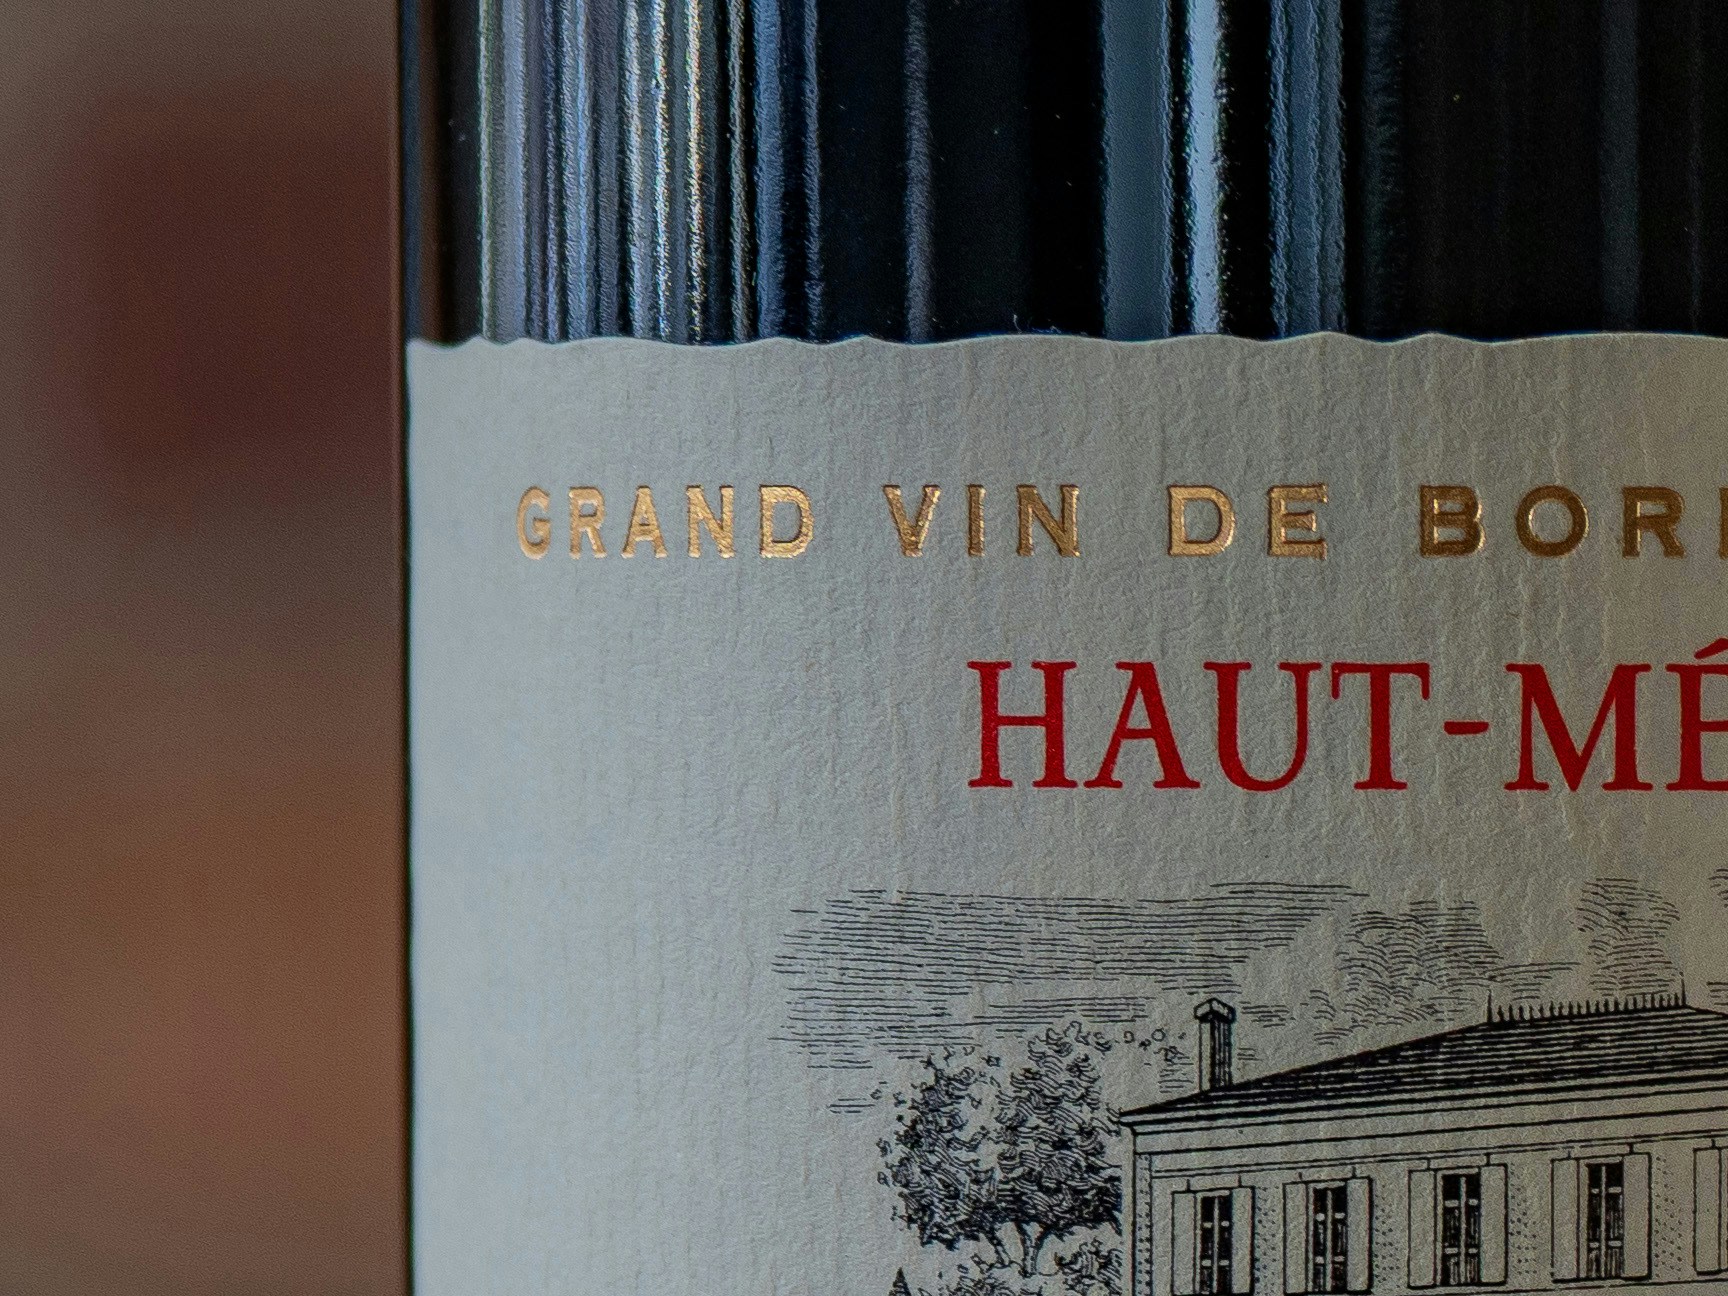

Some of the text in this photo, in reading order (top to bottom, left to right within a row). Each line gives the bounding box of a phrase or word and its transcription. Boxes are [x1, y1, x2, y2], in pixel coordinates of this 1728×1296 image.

[517, 484, 814, 558] GRAND
[882, 483, 1080, 557] VIN
[1166, 482, 1327, 559] DE
